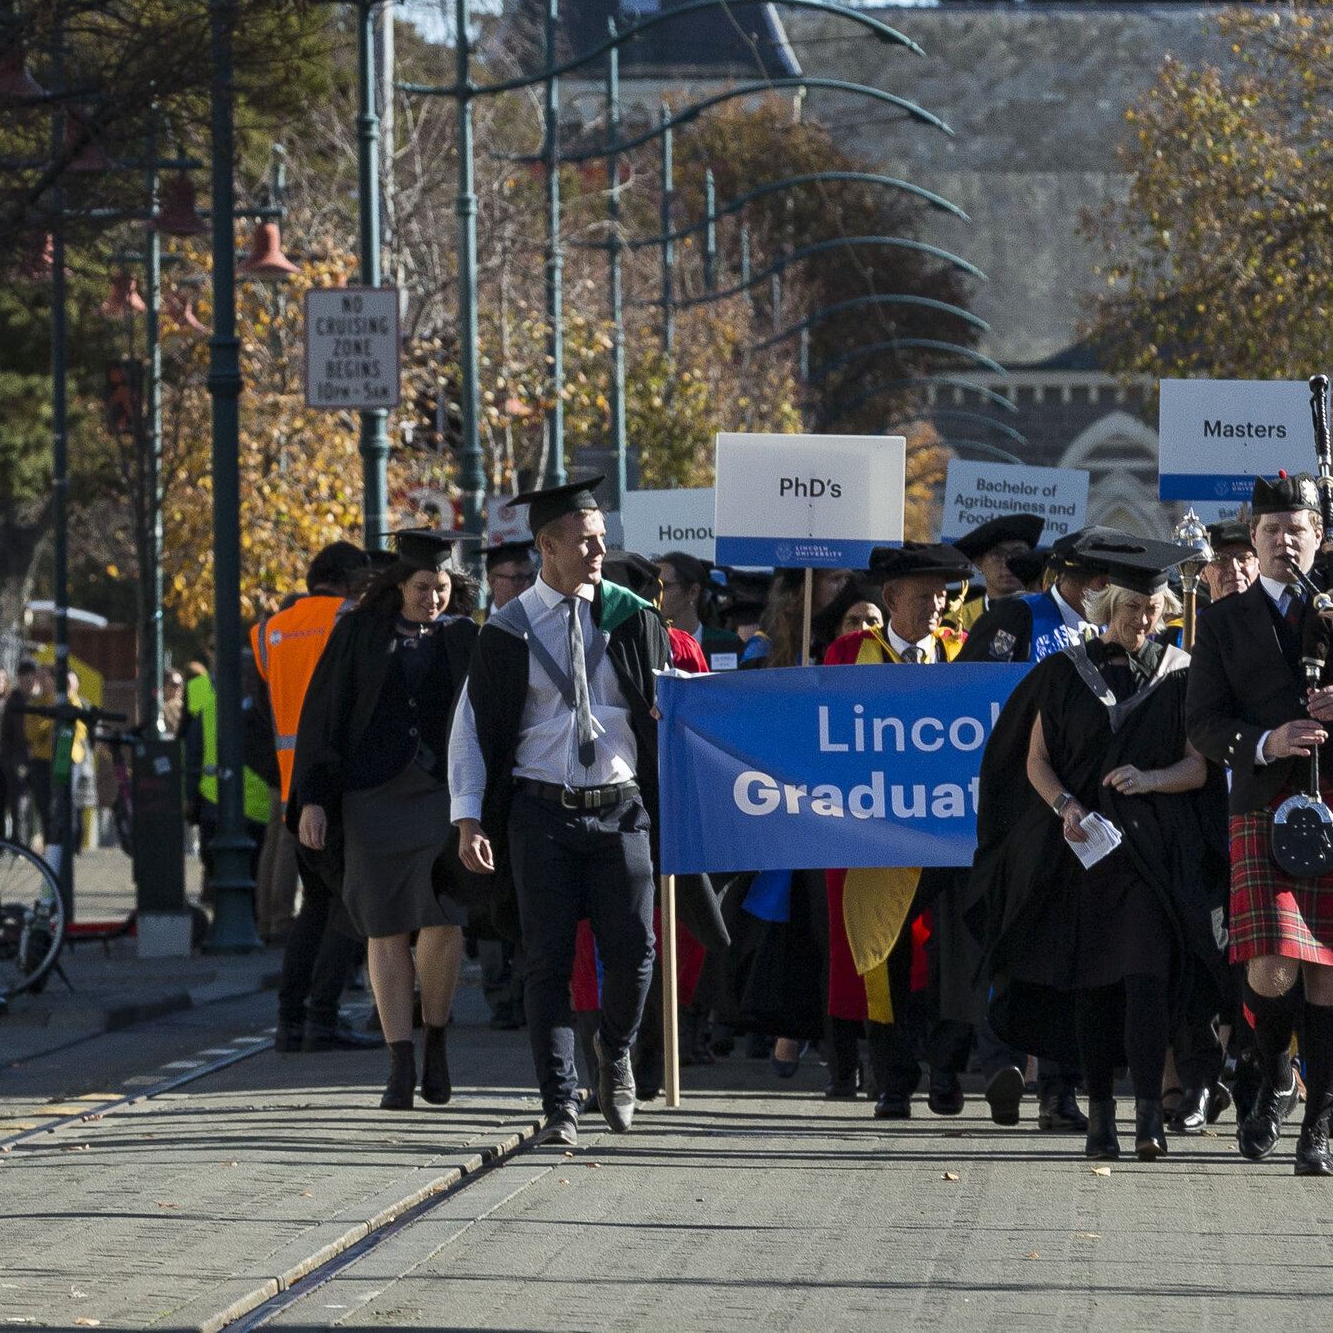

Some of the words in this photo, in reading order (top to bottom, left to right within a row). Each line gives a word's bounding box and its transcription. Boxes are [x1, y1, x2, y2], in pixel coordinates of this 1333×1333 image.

[342, 295, 363, 313] NO
[316, 316, 389, 336] CRUISING
[332, 337, 371, 357] ZONE
[325, 359, 380, 379] BEGINS
[1203, 419, 1287, 438] Masters
[780, 477, 842, 498] PhD's
[976, 478, 1039, 495] Bachelor
[1041, 484, 1057, 498] of
[954, 493, 1046, 513] Agribusiness
[1049, 503, 1076, 516] and
[958, 510, 994, 524] Food
[659, 524, 715, 541] Honou
[819, 702, 1001, 753] Lincol
[733, 770, 981, 819] Graduat
